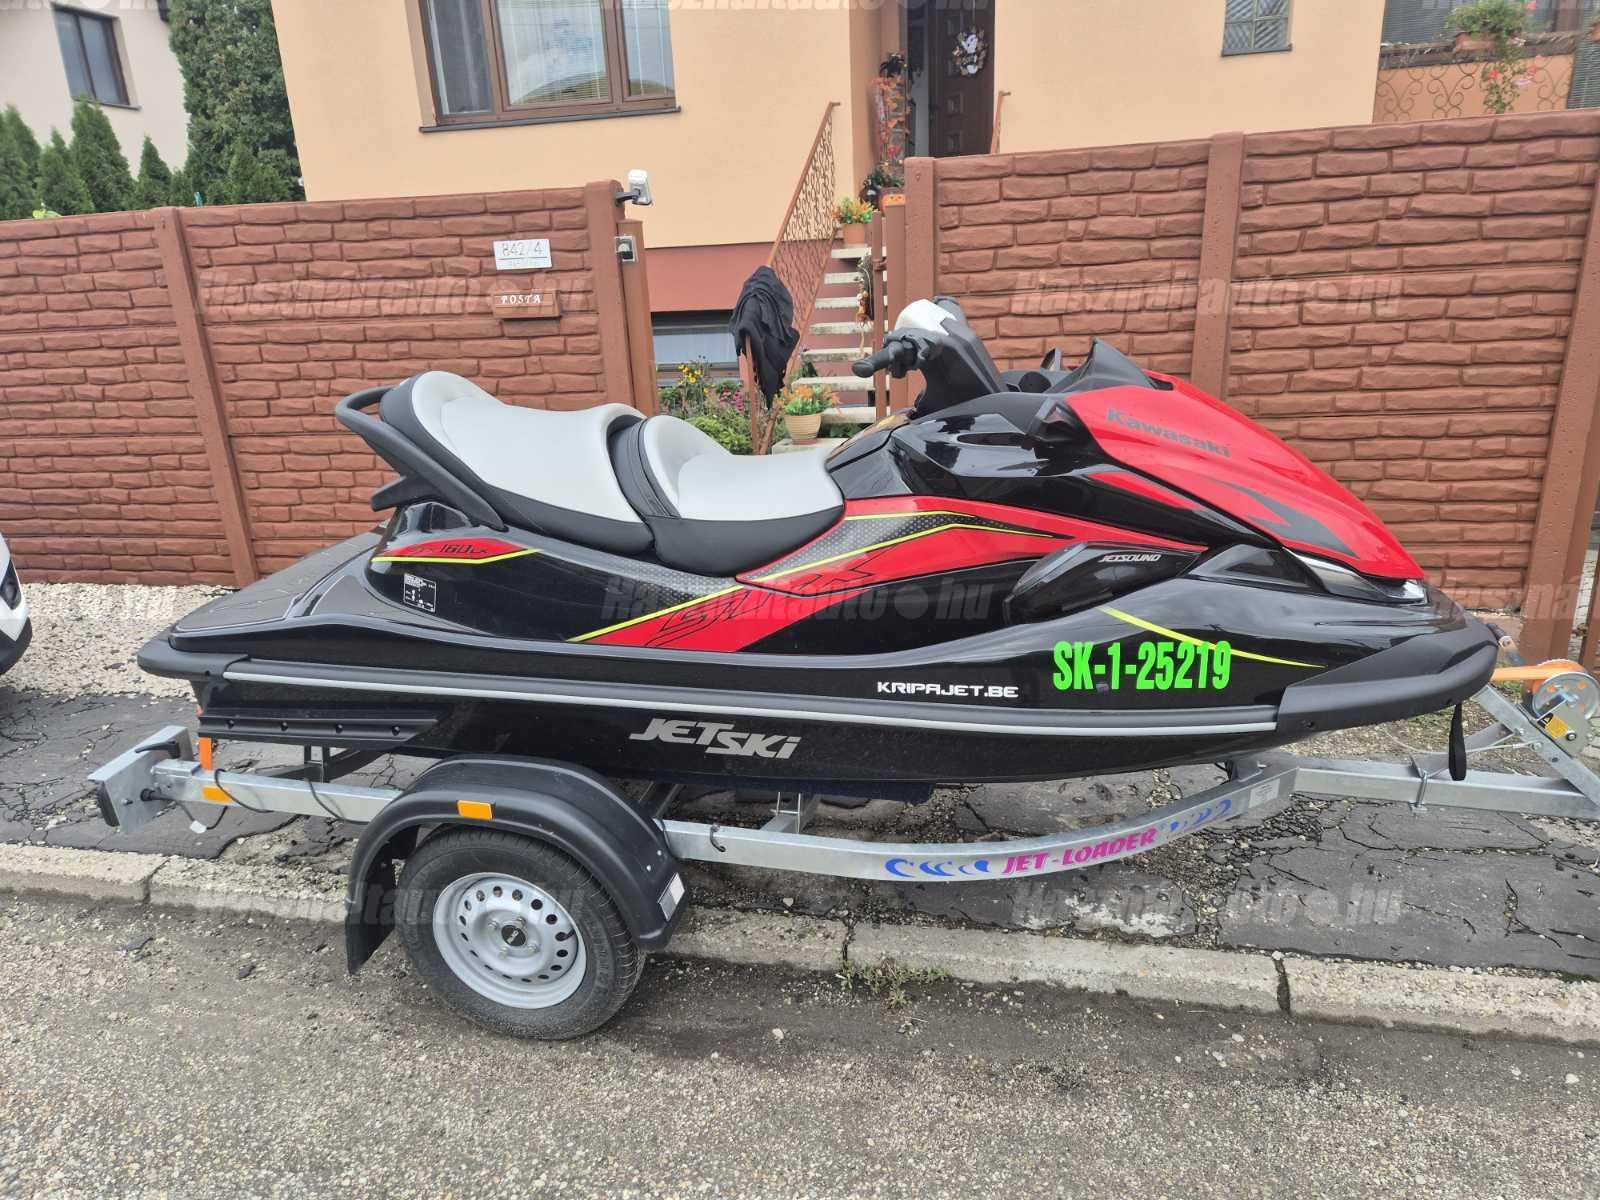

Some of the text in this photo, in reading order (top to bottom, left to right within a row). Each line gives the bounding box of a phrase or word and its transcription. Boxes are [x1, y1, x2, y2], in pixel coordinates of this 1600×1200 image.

[1107, 408, 1231, 457] Kawasaki
[1098, 554, 1161, 563] JETSOUND
[1052, 640, 1232, 690] SK-1-25219
[877, 681, 1019, 698] KRIPAJET.BE
